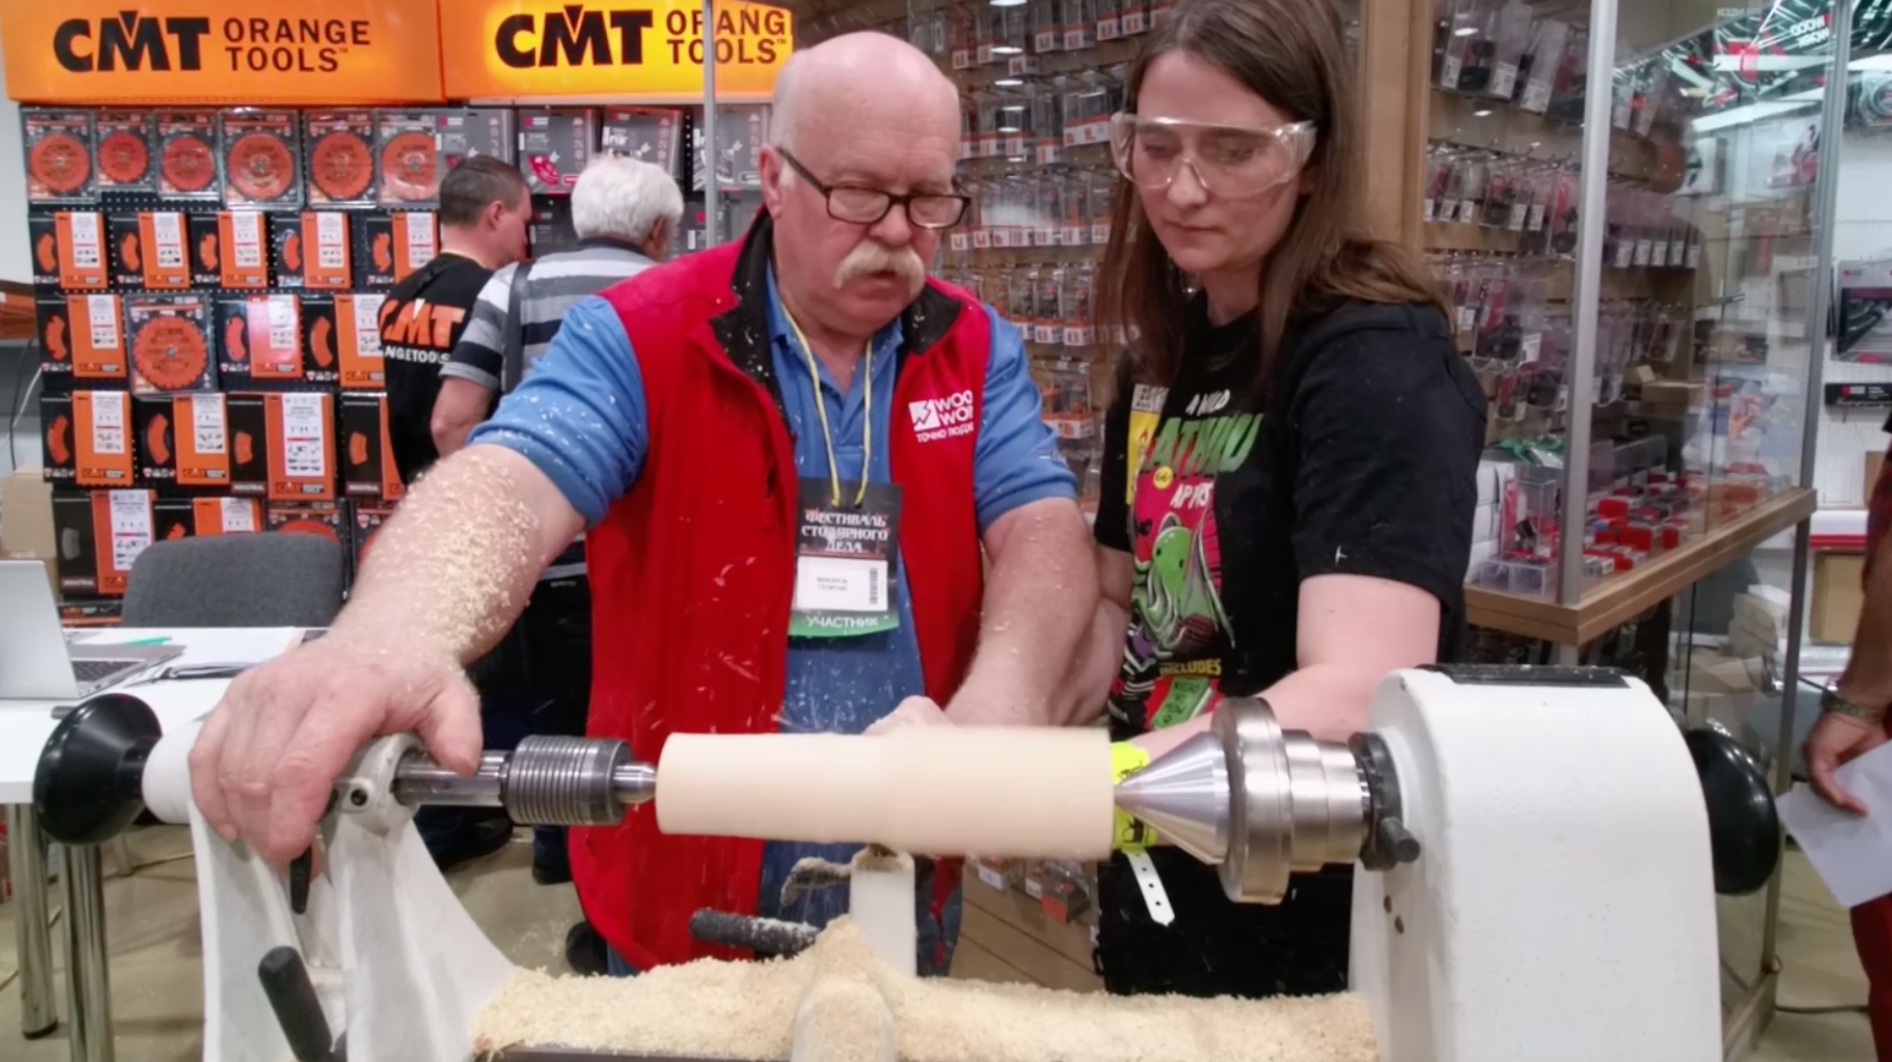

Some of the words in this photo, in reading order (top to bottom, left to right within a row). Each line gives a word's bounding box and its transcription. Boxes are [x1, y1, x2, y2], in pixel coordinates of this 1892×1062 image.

[53, 10, 209, 72] CMT
[223, 18, 371, 45] ORANGE
[495, 5, 653, 68] CMT
[804, 508, 887, 527] ФЕСТИВАЛЬ
[801, 524, 888, 542] СТОЛЯРНОГО
[825, 537, 863, 554] ДЕЛА
[806, 614, 878, 628] УЧАСТНИК
